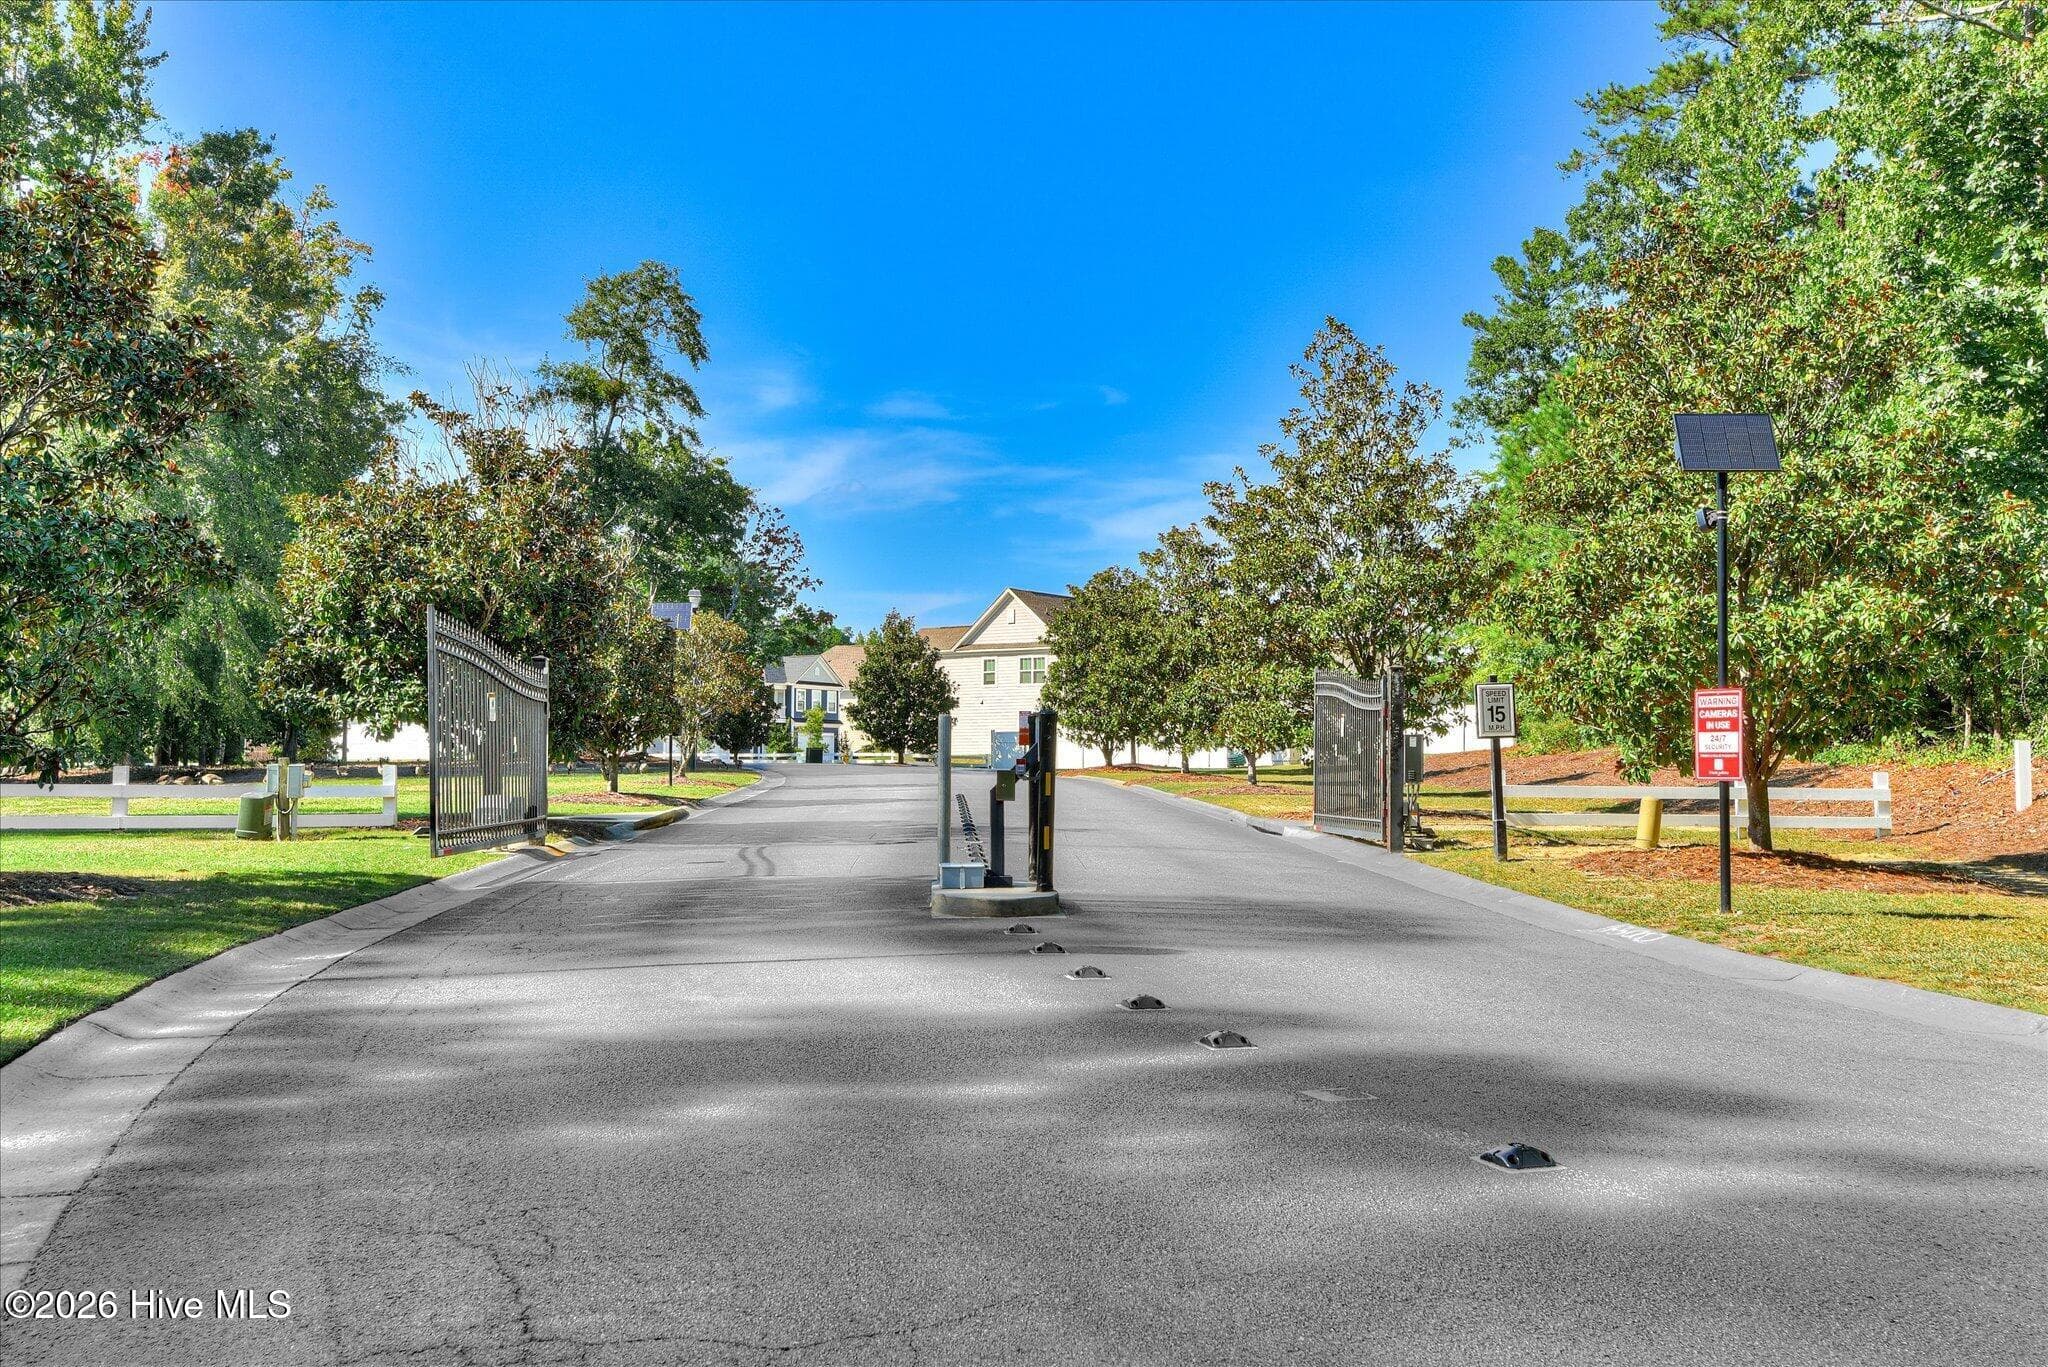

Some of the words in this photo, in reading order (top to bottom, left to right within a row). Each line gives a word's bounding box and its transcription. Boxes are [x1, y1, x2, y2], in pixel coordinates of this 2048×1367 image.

[1699, 697, 1737, 706] WARNING
[1487, 705, 1506, 723] 15
[1699, 709, 1738, 718] CAMERAS
[1705, 720, 1714, 730] IN
[1714, 720, 1731, 730] USE
[1710, 734, 1727, 742] 24/7
